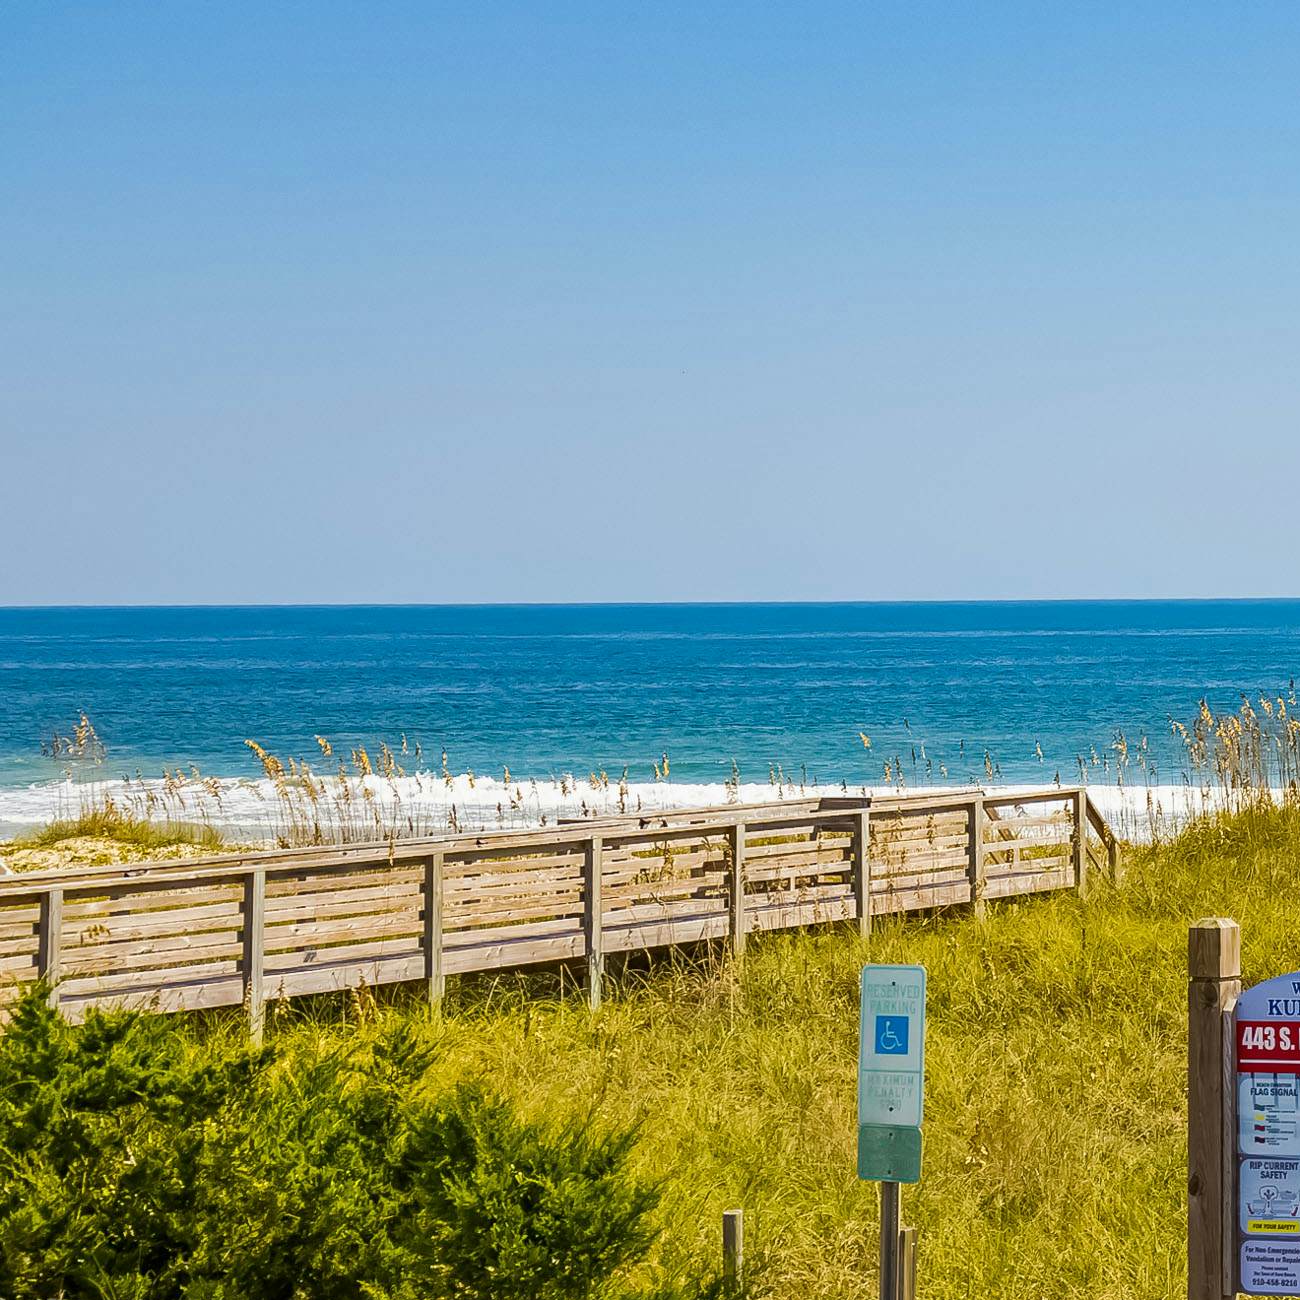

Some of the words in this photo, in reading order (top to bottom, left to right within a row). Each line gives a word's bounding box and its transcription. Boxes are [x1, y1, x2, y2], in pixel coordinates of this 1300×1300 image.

[867, 984, 920, 998] RESERVED
[871, 1000, 916, 1013] PARKING
[1242, 1026, 1276, 1050] 443
[1279, 1027, 1296, 1050] S.
[1250, 1088, 1269, 1096] FLAG
[1270, 1088, 1298, 1097] SIGNAL
[1250, 1161, 1262, 1170] RIP
[1264, 1162, 1299, 1171] CURRENT
[1260, 1171, 1287, 1179] SAFETY
